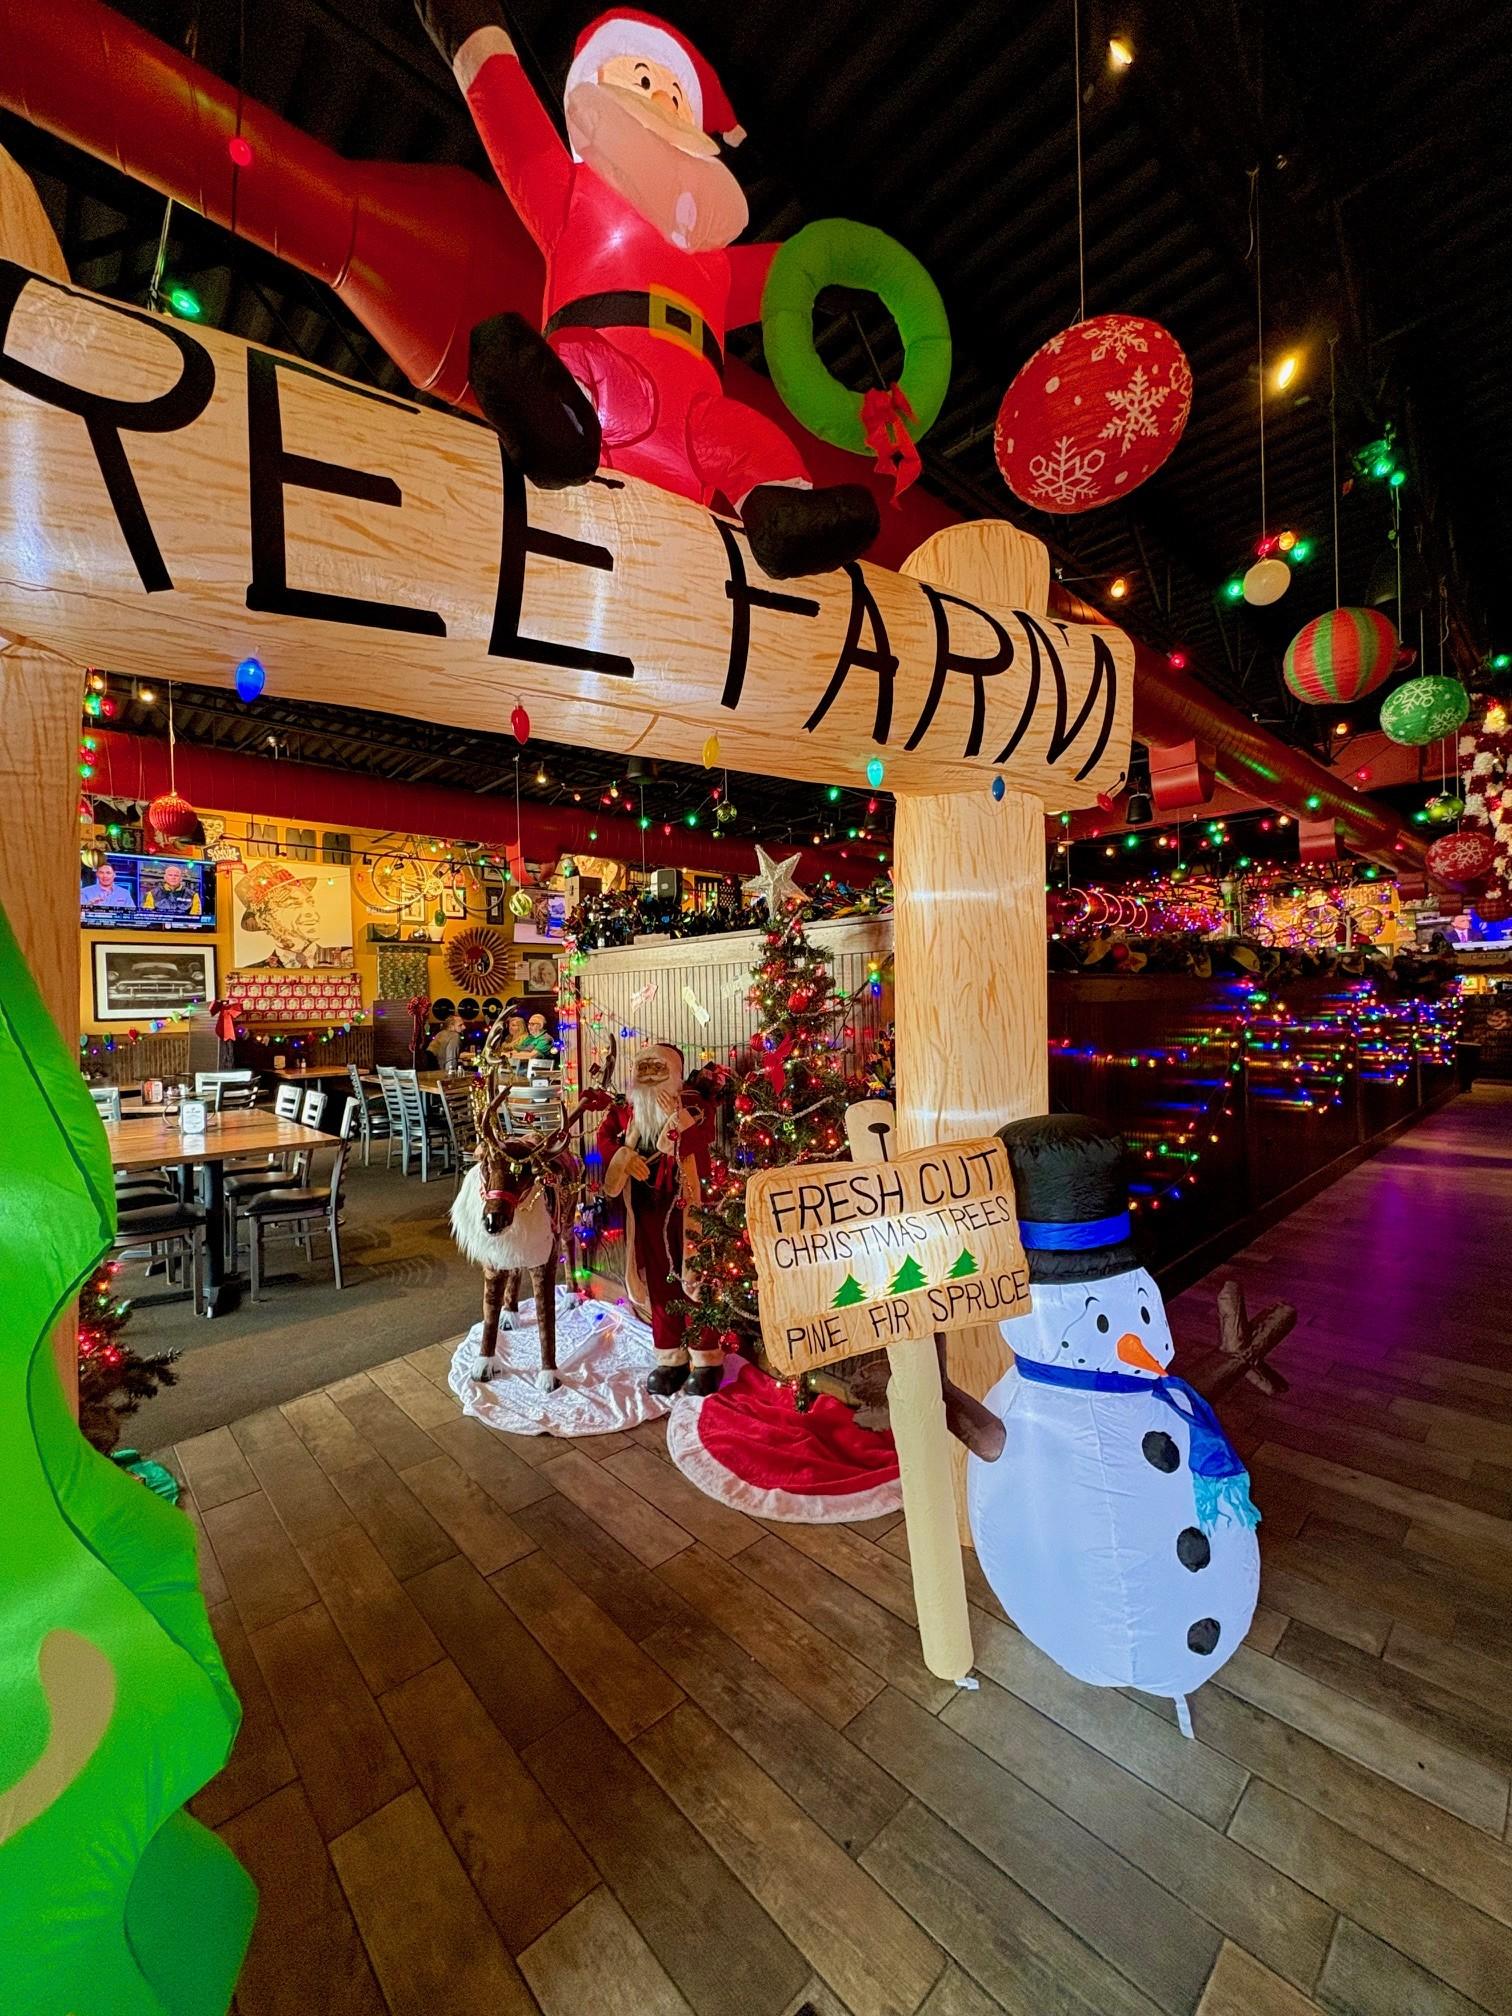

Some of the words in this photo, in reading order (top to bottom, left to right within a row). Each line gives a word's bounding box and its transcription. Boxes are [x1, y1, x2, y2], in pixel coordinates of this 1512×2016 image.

[711, 513, 1117, 782] FARM
[769, 1170, 905, 1234] FRESH
[918, 1148, 998, 1206] CUT
[773, 1215, 928, 1270] CHRISTMAS
[926, 1195, 1011, 1237] TREES
[786, 1316, 849, 1361] PINE
[868, 1299, 912, 1339] FIR
[926, 1268, 1030, 1323] SPRUCE
